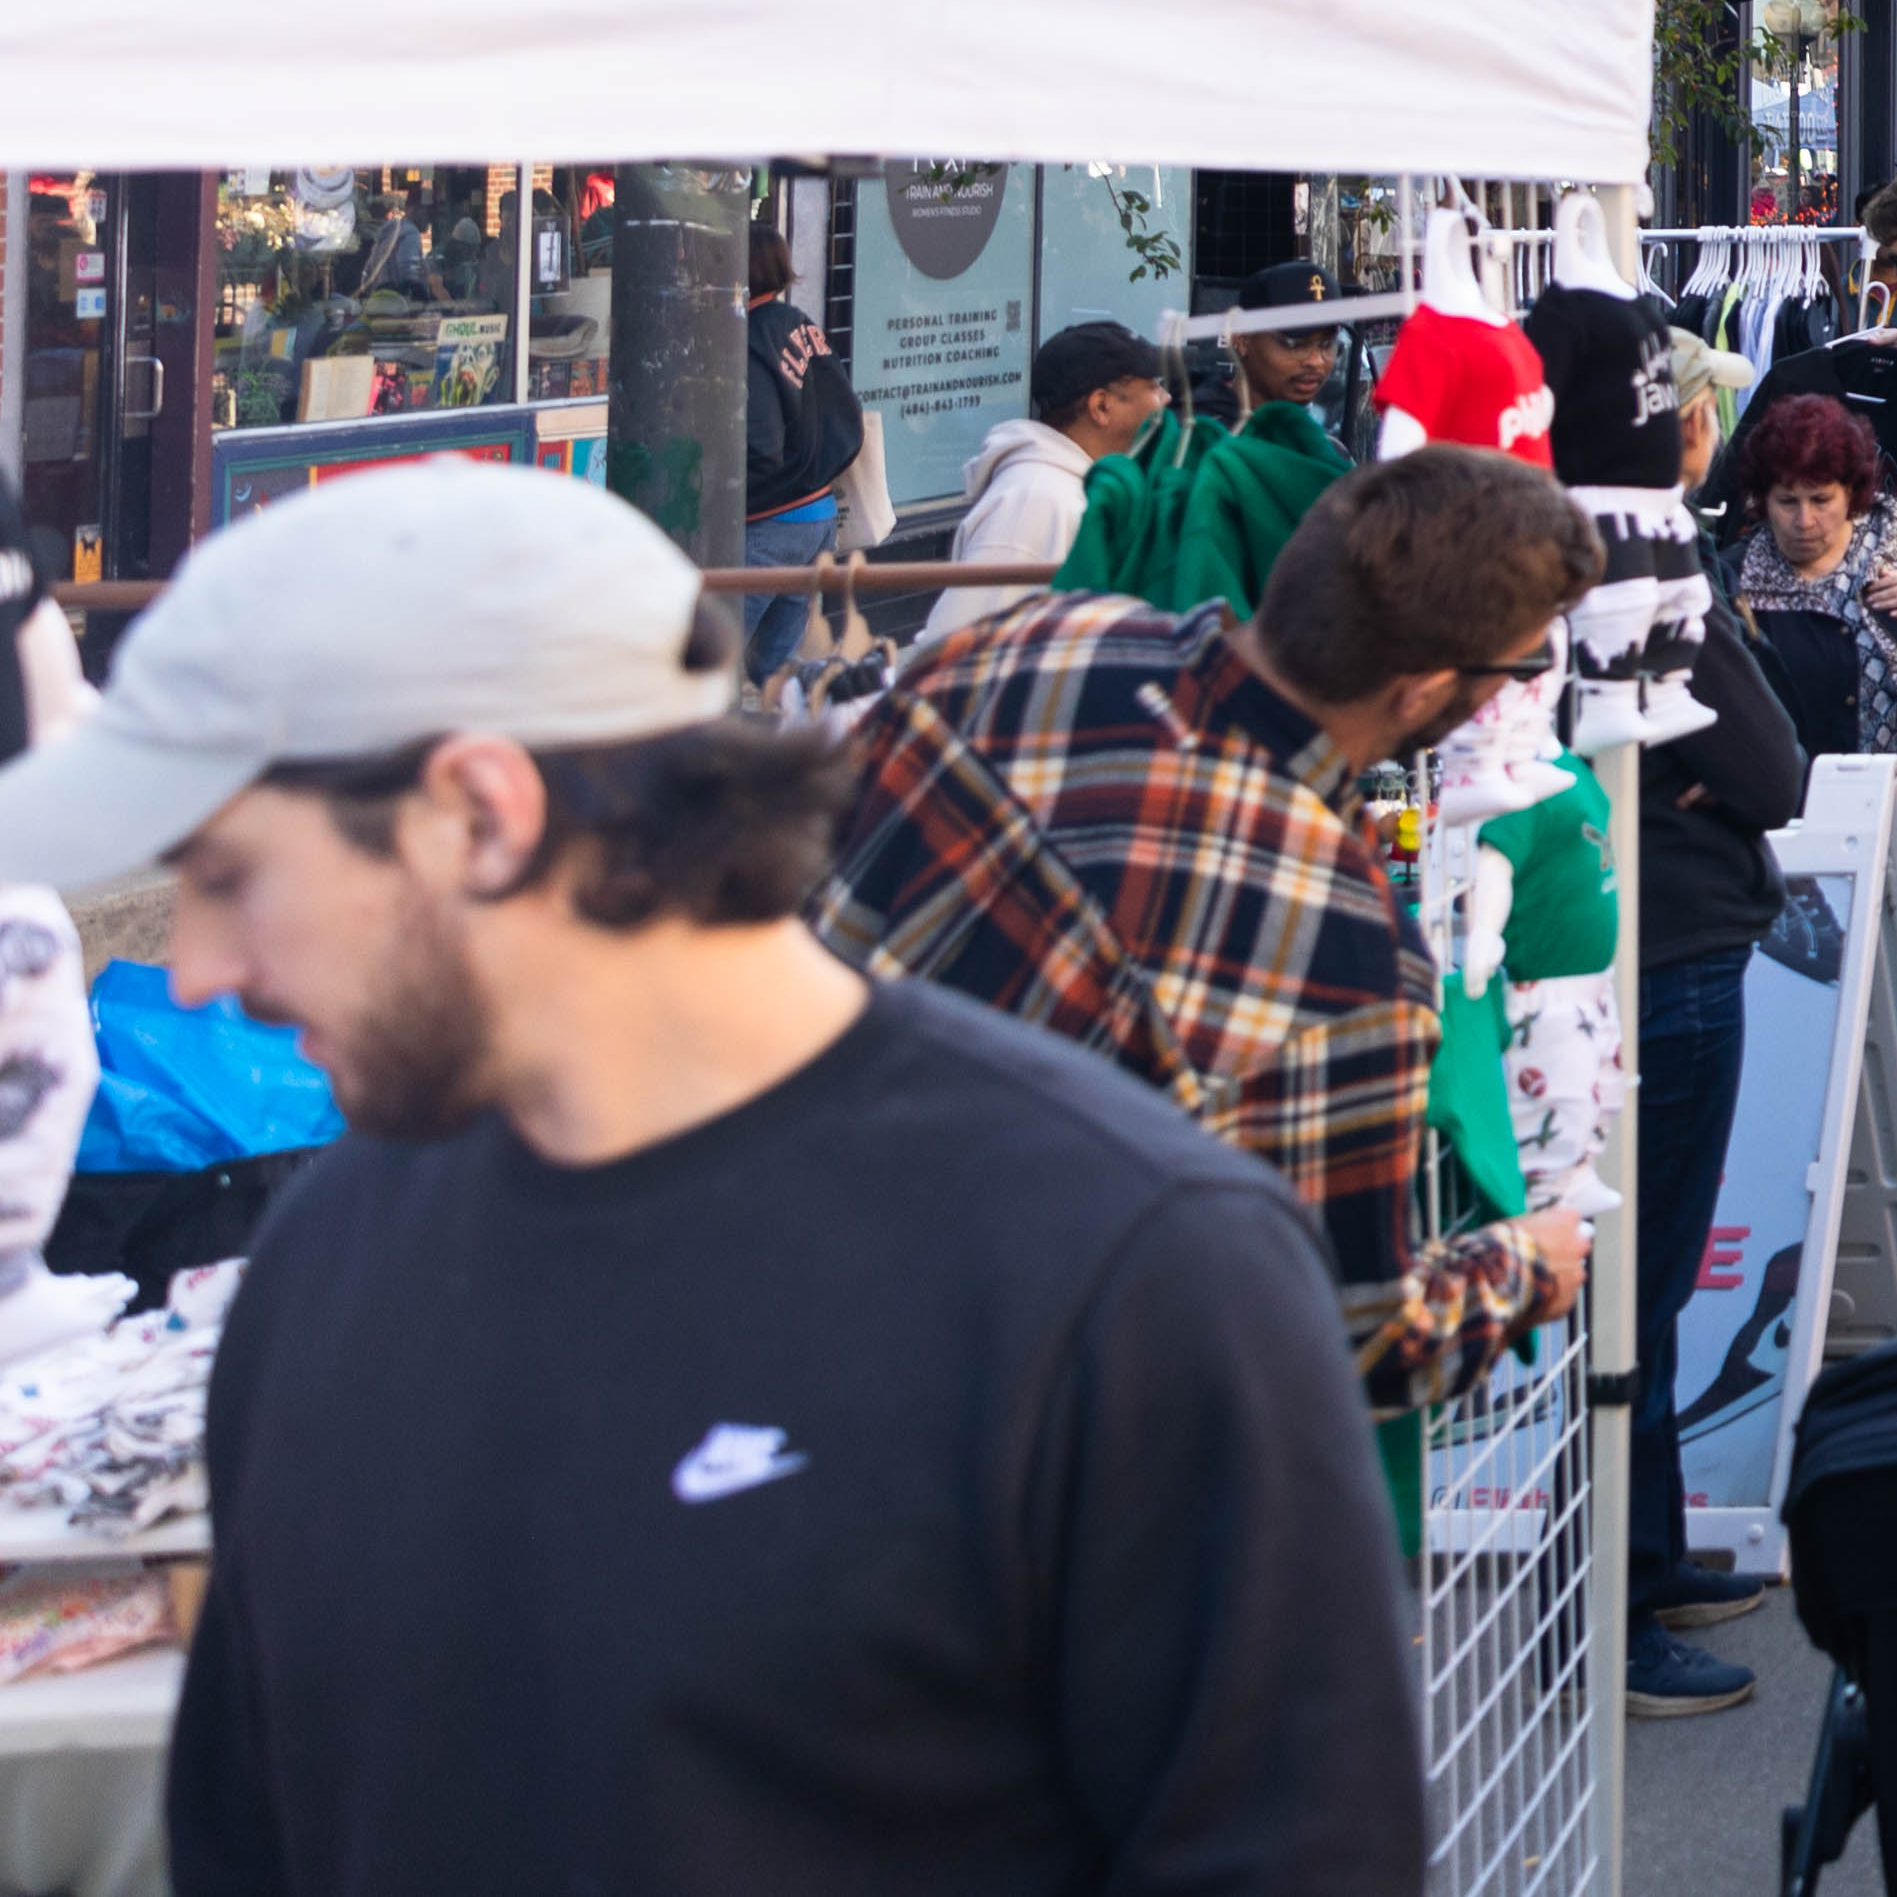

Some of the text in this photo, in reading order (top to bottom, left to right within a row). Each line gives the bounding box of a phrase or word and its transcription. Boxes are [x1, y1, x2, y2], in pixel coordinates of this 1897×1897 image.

[886, 309, 998, 331] PERSONAL TRAINING
[899, 329, 985, 350] GROUP CLASSES
[882, 346, 1000, 370] NUTRITION COACHING
